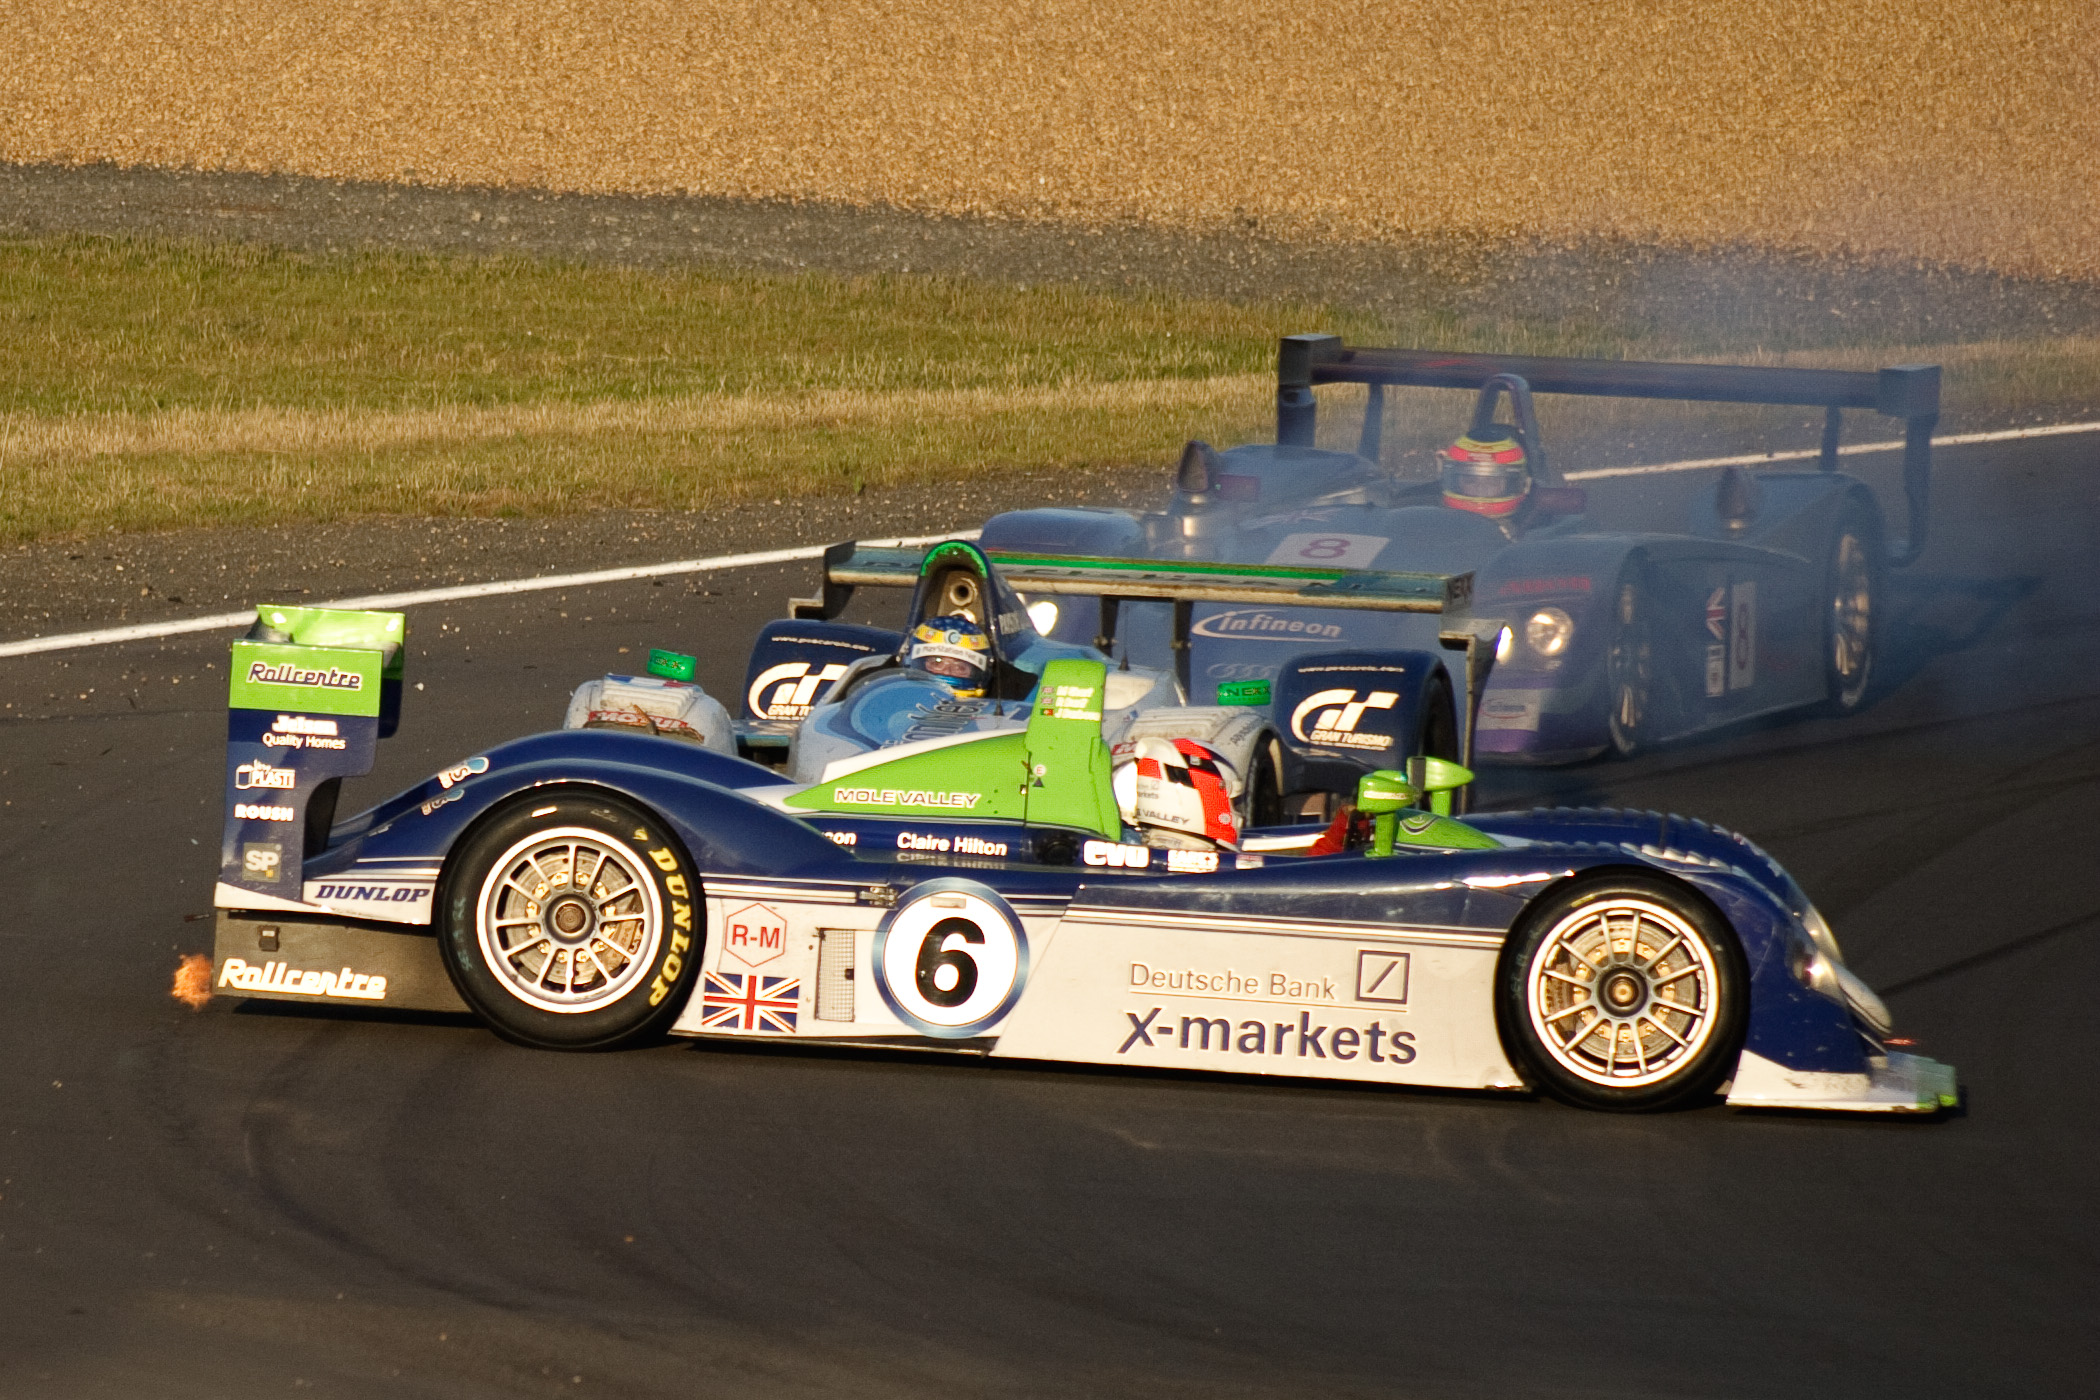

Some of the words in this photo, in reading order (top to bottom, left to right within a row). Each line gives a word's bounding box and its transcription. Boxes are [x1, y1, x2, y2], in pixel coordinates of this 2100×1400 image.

[1301, 537, 1351, 560] 8
[248, 662, 362, 690] Rollcentre
[767, 704, 798, 717] GRAN
[262, 732, 303, 750] Quality
[305, 735, 346, 750] Homes
[1310, 730, 1341, 743] GRAN
[1342, 732, 1394, 747] TURISMO
[834, 788, 896, 804] MOLE
[898, 790, 981, 809] VALLEY
[234, 803, 294, 822] ROUSH
[897, 831, 950, 852] Claire
[952, 836, 1008, 857] Hilton
[245, 850, 280, 872] SP
[315, 884, 431, 903] DUNLOP
[648, 846, 693, 1007] DUNLOP
[731, 924, 780, 949] R-M
[915, 916, 986, 1008] 6
[217, 958, 388, 999] Rollcentre
[1130, 963, 1259, 994] Deutsche
[1269, 973, 1337, 1000] Bank
